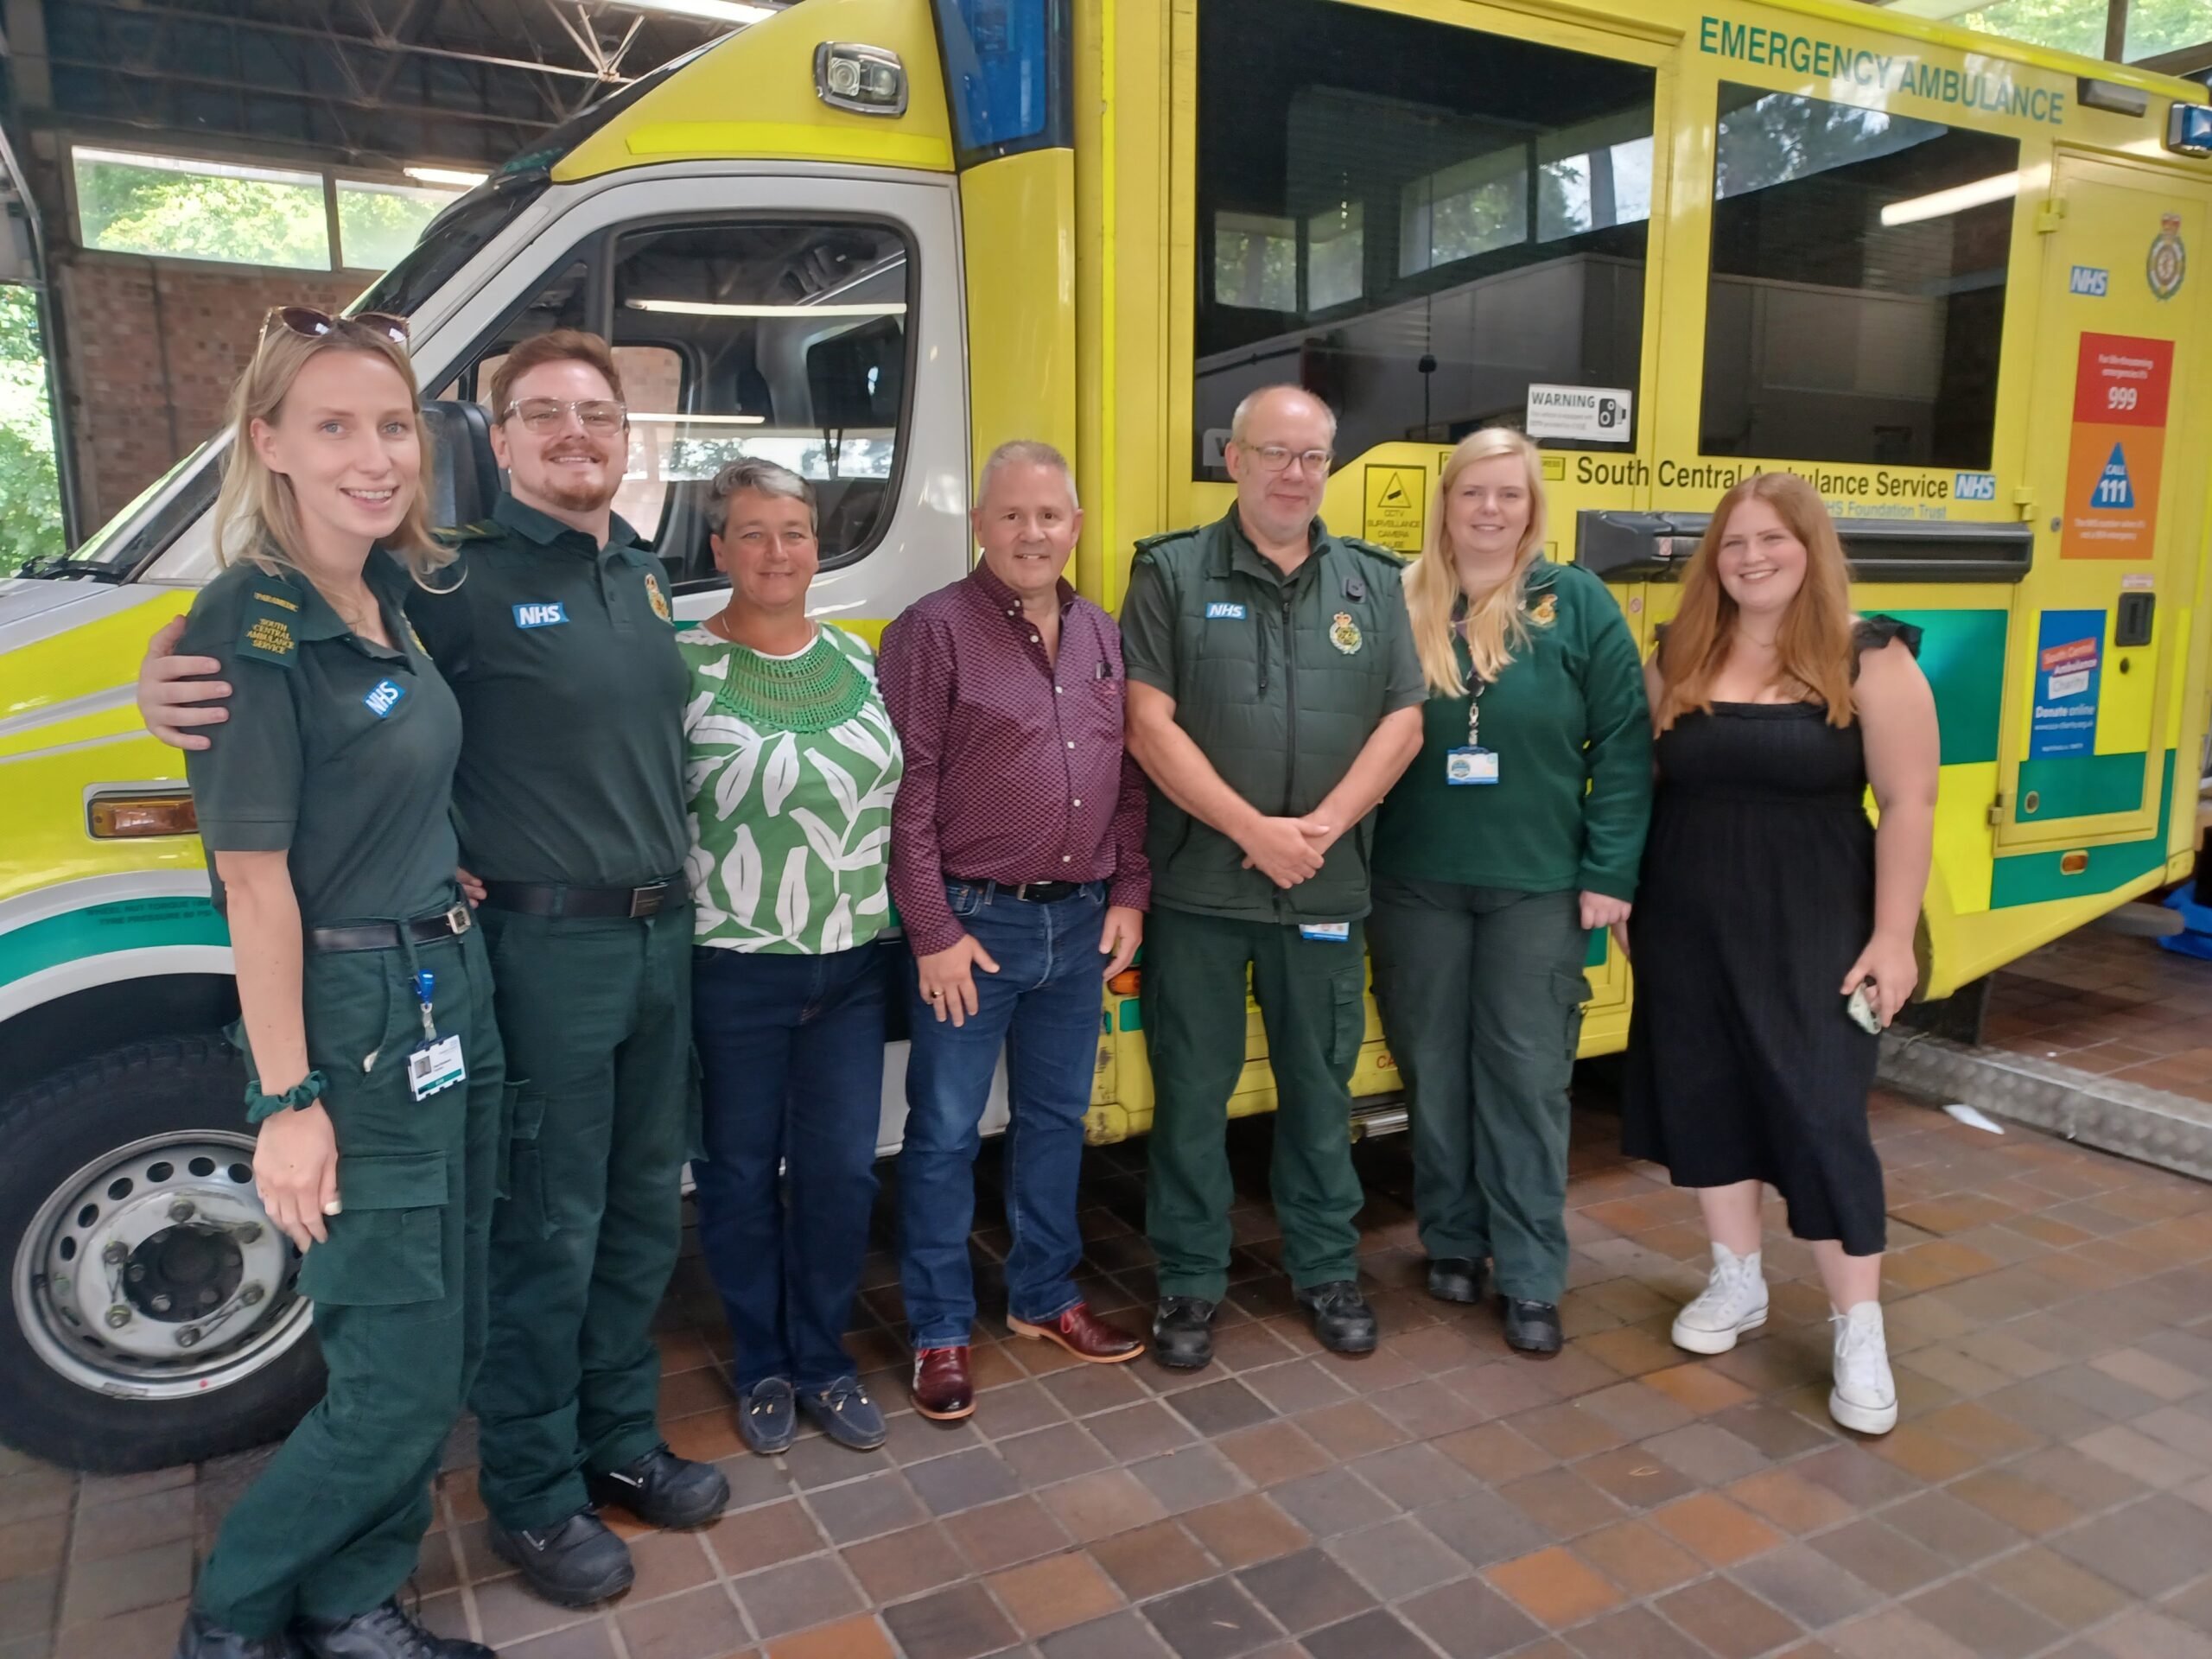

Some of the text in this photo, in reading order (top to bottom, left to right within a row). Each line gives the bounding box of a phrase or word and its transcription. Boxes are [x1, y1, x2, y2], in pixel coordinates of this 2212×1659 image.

[1700, 16, 2064, 124] EMERGENCY AMBULANCE
[2070, 267, 2108, 296] NHS
[1532, 391, 1596, 408] WARNING
[2107, 386, 2138, 410] 999
[1576, 455, 1649, 486] South
[1657, 460, 1743, 489] Central
[1876, 471, 1948, 499] Service
[1955, 474, 1995, 499] NHS
[2105, 464, 2126, 475] CALL
[2100, 479, 2127, 503] 111
[1847, 501, 1915, 518] Foundation
[1919, 504, 1948, 520] Trust
[1377, 530, 1409, 538] CAMERA
[519, 605, 561, 626] NHS
[1209, 603, 1244, 617] NHS
[365, 681, 399, 715] NHS
[2035, 702, 2095, 718] Donate online
